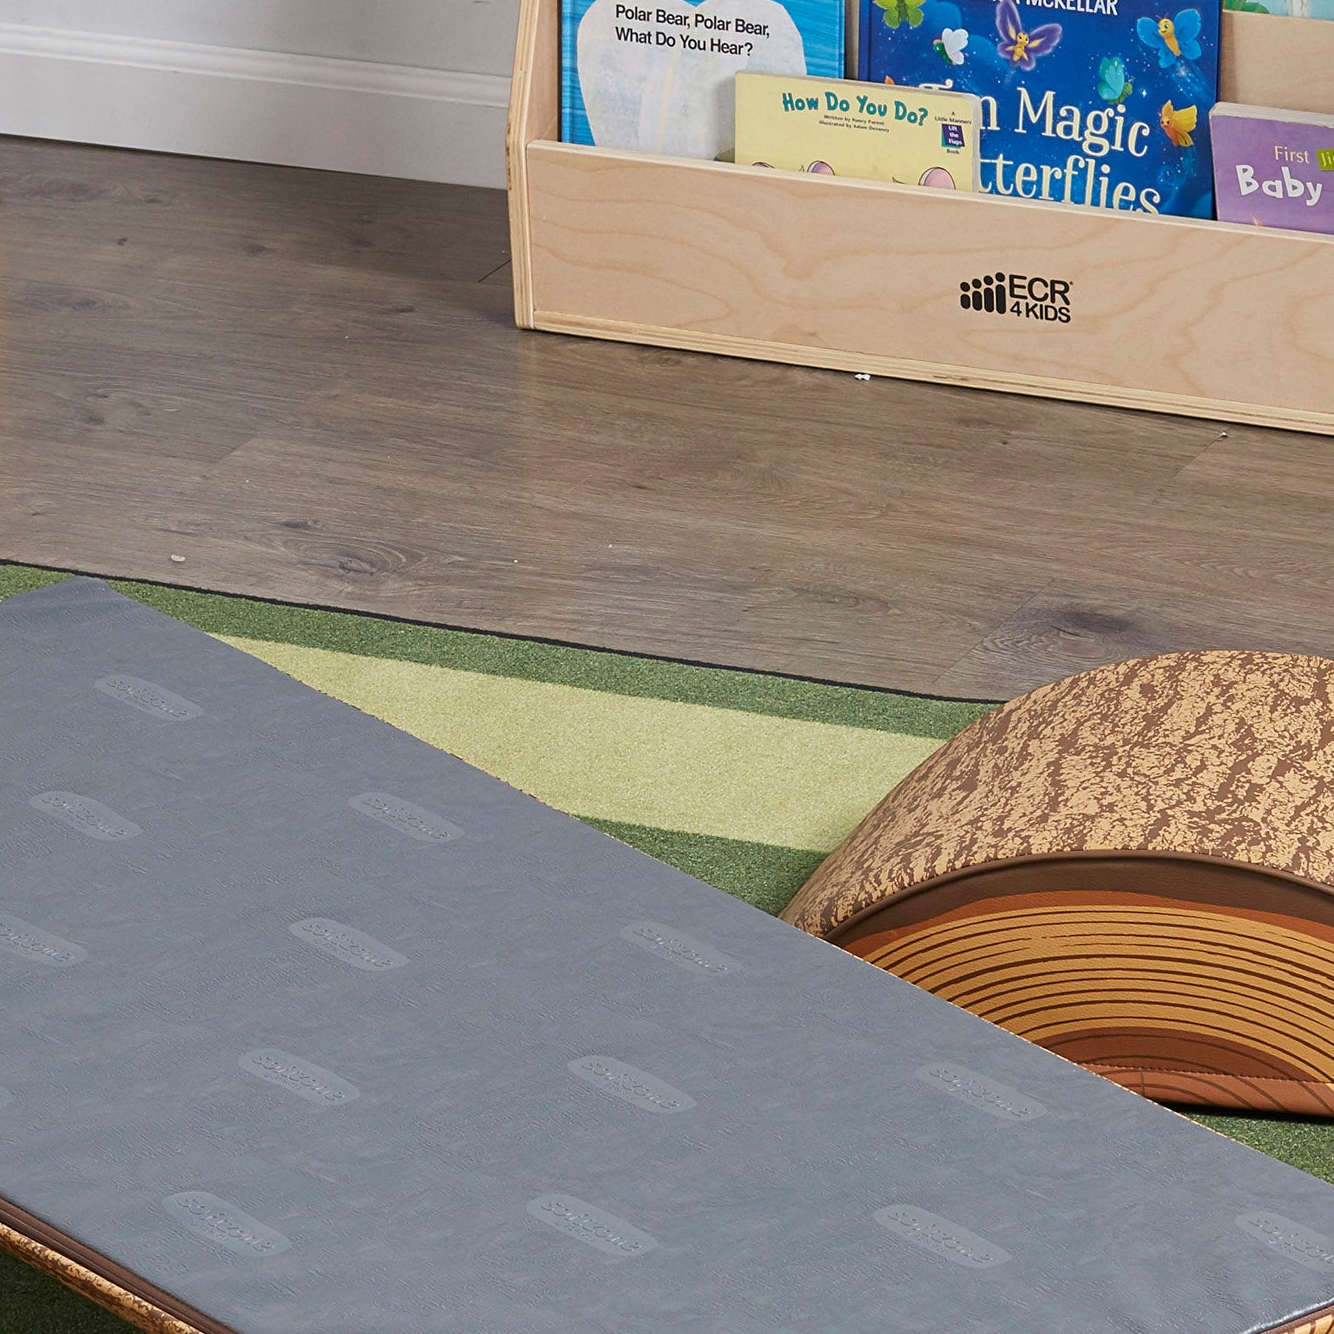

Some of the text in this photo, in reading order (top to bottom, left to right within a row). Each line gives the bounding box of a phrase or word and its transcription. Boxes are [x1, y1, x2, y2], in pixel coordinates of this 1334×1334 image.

[615, 4, 771, 40] Polar Bear, Polar Bear,
[615, 26, 754, 57] What Do You Hear?
[782, 92, 819, 112] How
[824, 91, 851, 112] Do
[856, 95, 888, 117] You
[894, 100, 929, 127] Do?
[1014, 86, 1150, 157] Magic
[1274, 145, 1310, 164] First
[980, 154, 1161, 215] terflies
[1235, 164, 1323, 207] Baby
[1009, 274, 1070, 306] ECR
